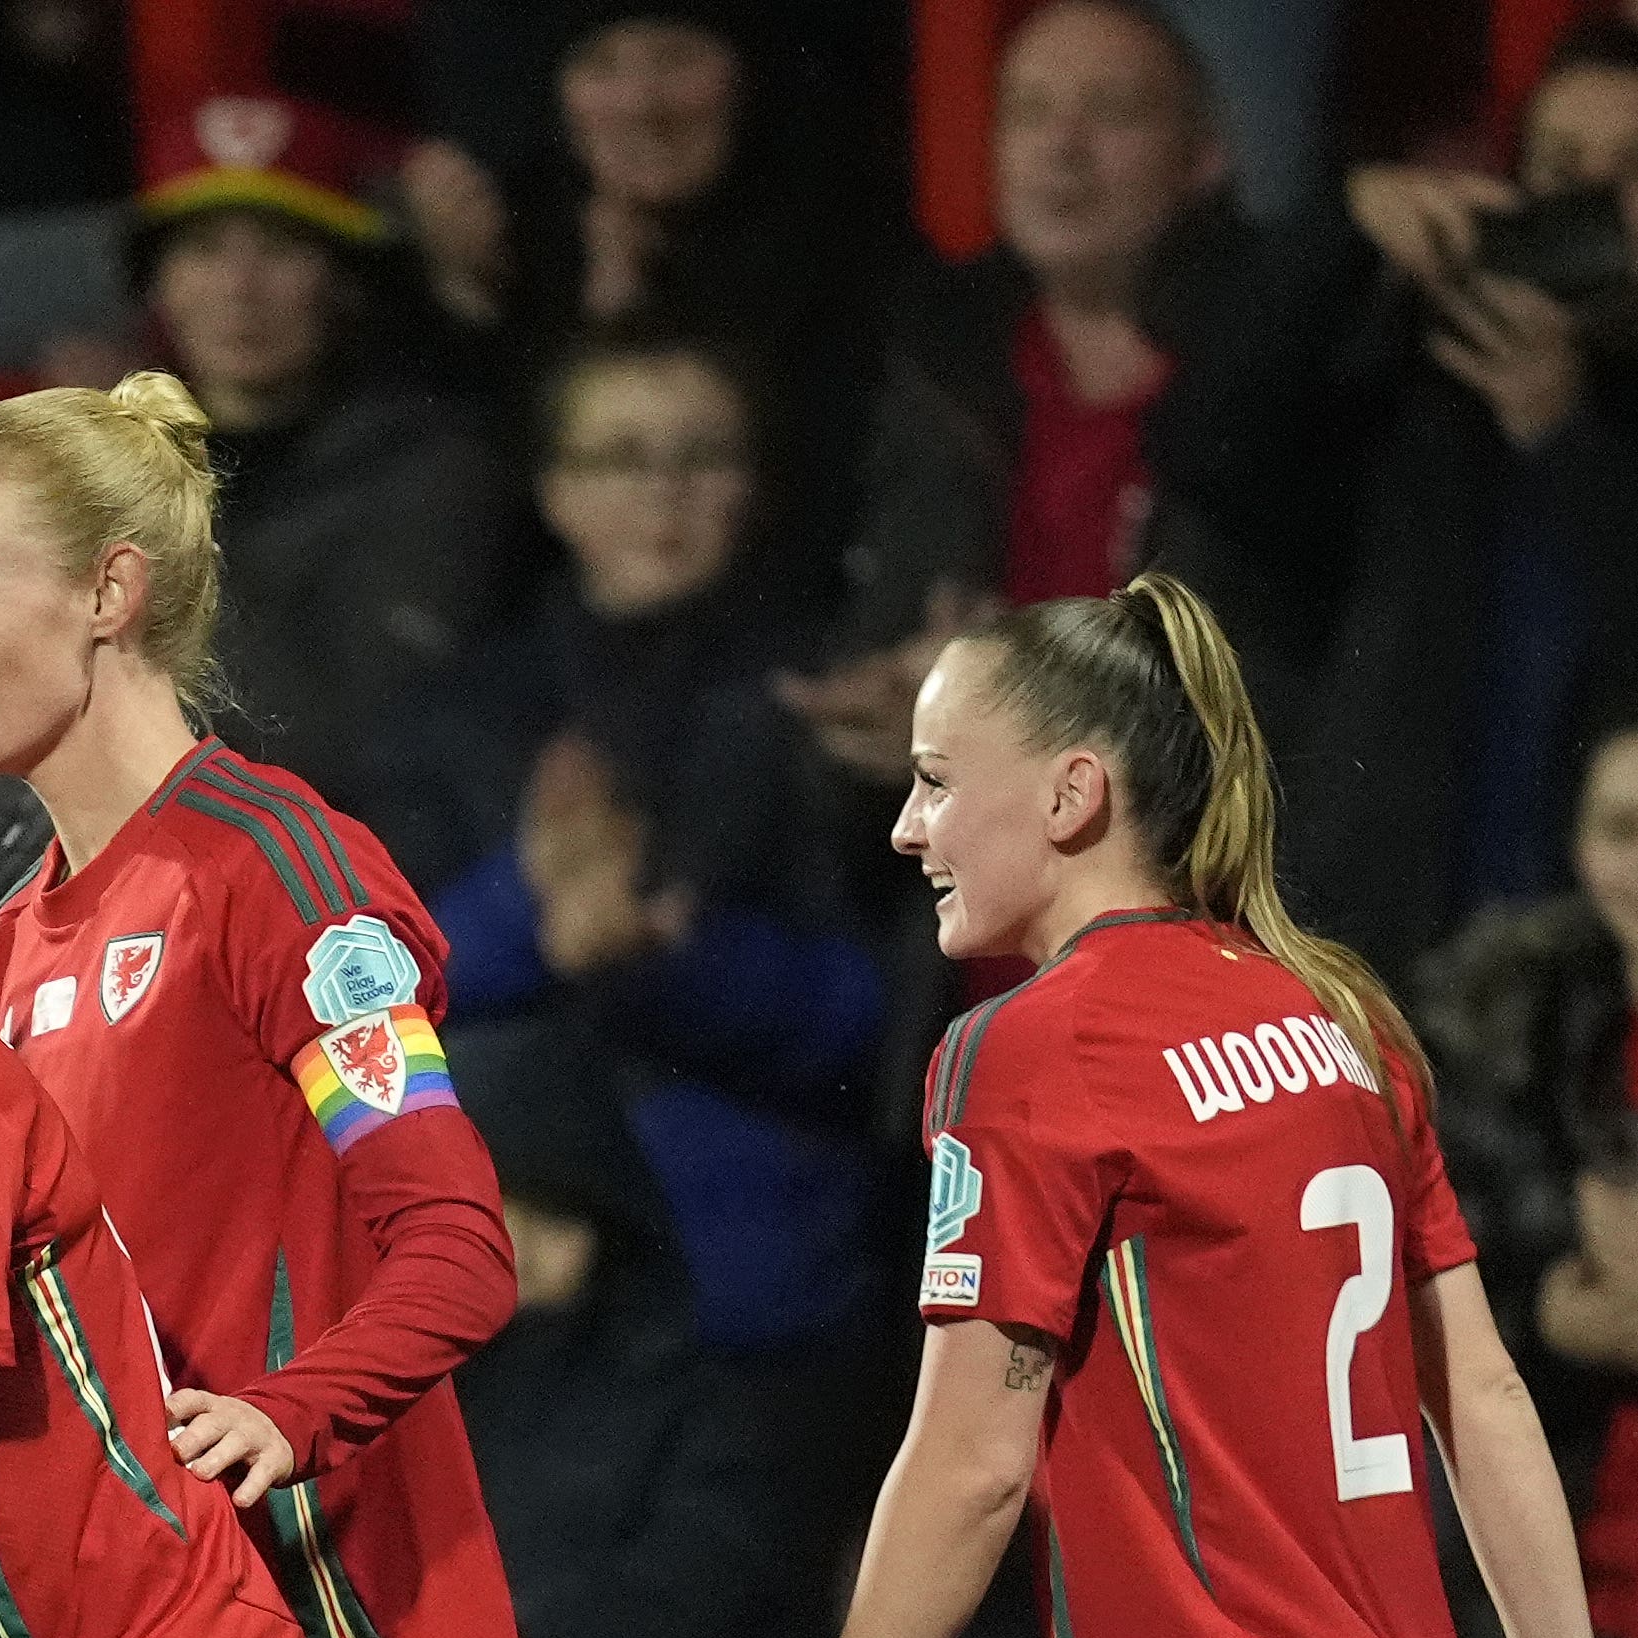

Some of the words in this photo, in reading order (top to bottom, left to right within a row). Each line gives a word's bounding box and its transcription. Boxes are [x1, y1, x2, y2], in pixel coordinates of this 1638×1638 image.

[340, 964, 363, 979] We
[351, 981, 395, 1006] Strong
[1300, 1163, 1414, 1502] 2
